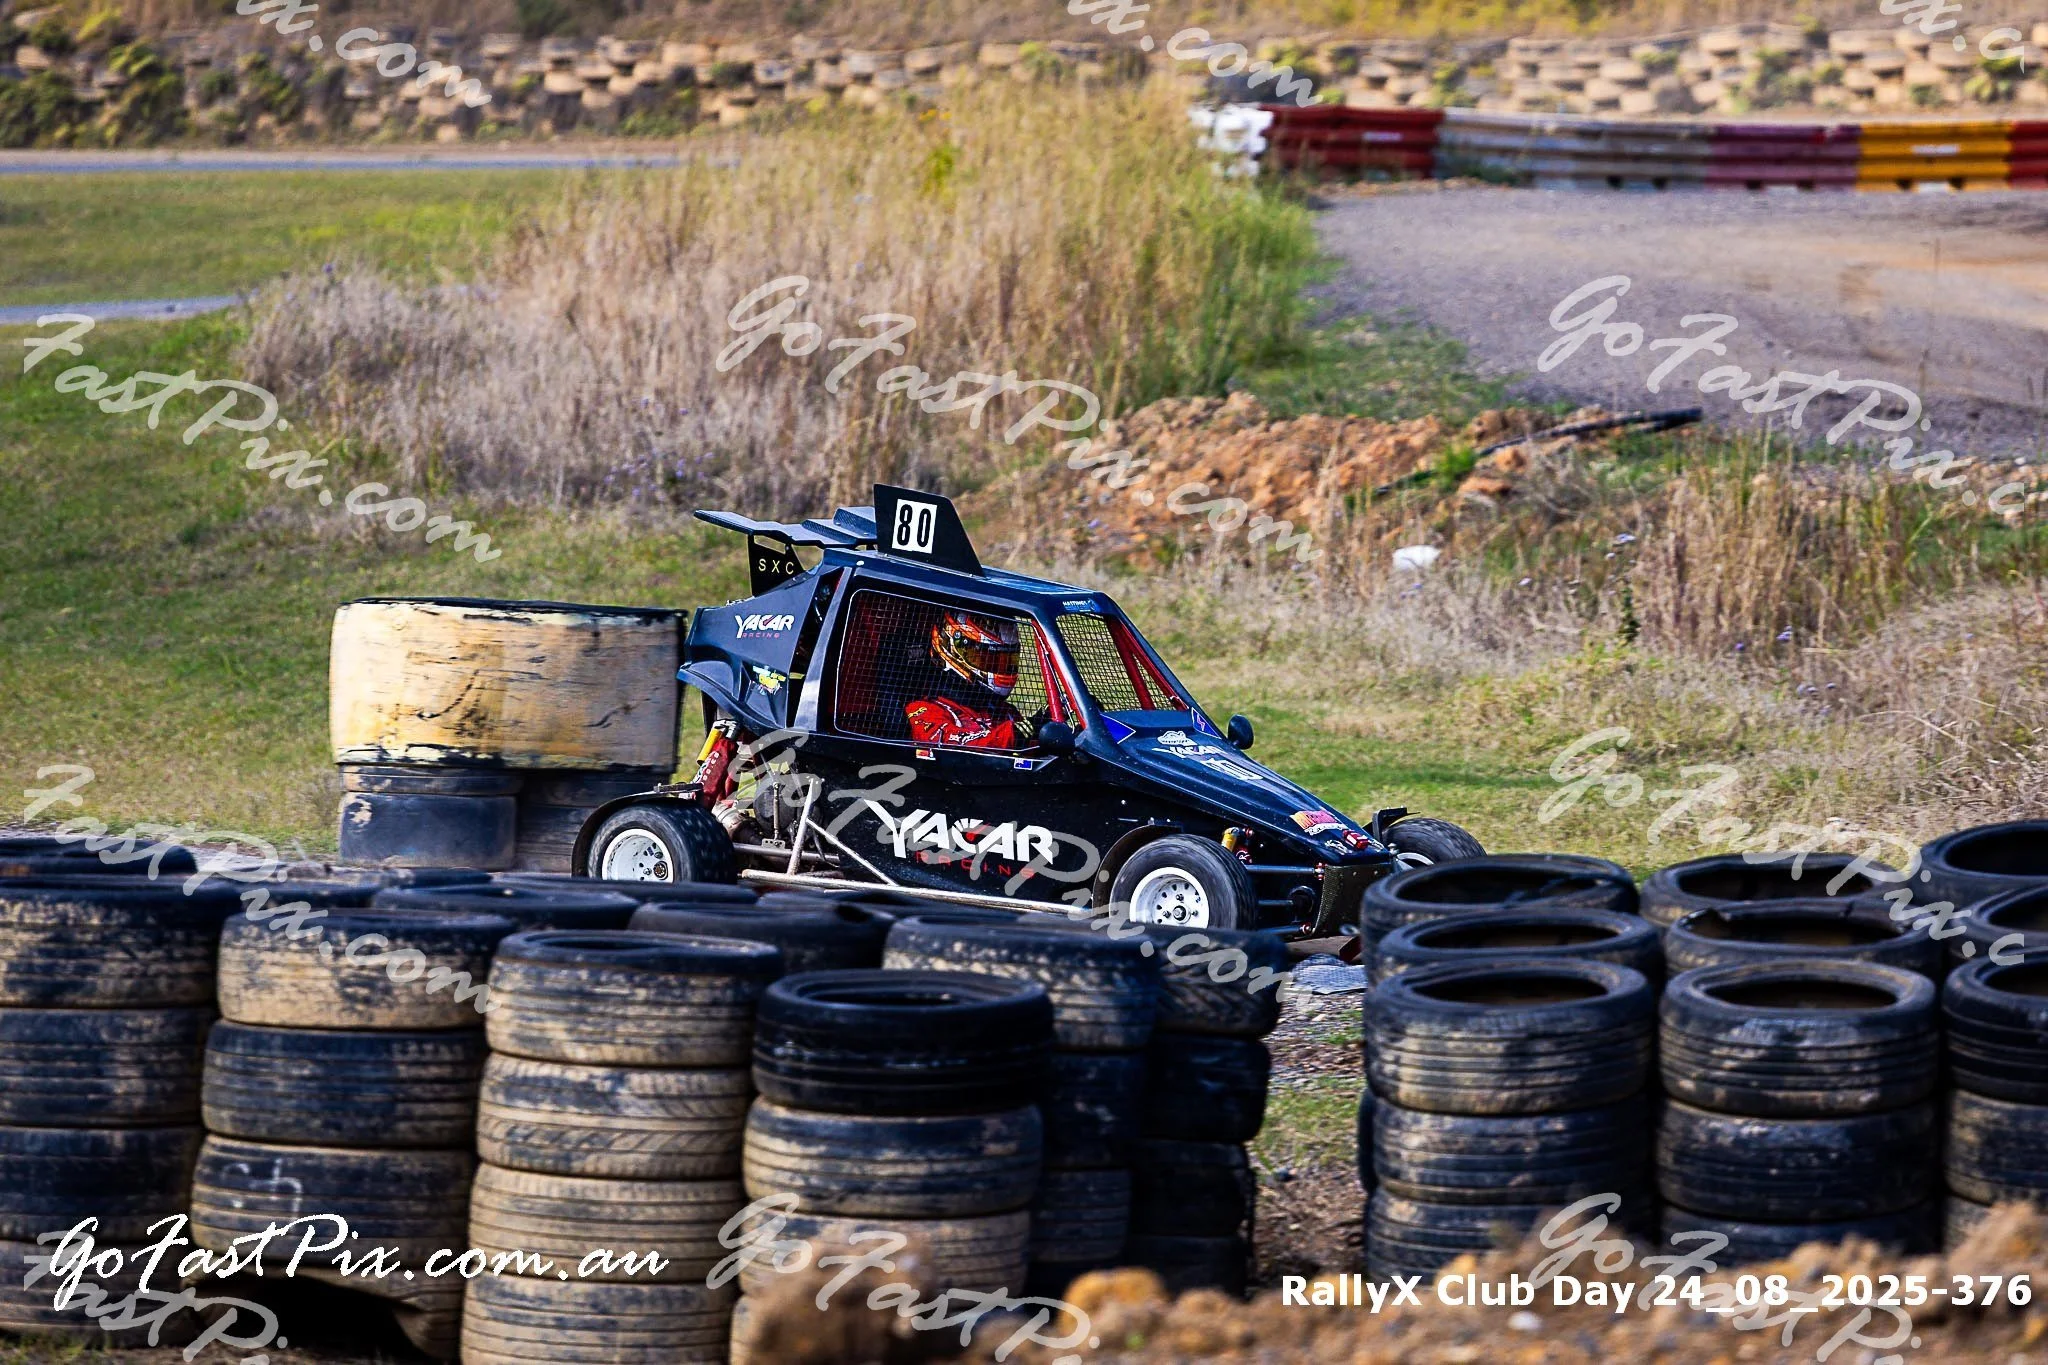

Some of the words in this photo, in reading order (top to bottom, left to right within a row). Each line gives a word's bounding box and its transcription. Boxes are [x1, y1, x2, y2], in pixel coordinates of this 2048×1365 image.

[896, 504, 931, 547] 80
[735, 614, 795, 639] YACAR
[864, 799, 1054, 864] YACAR
[914, 850, 1036, 880] RACING
